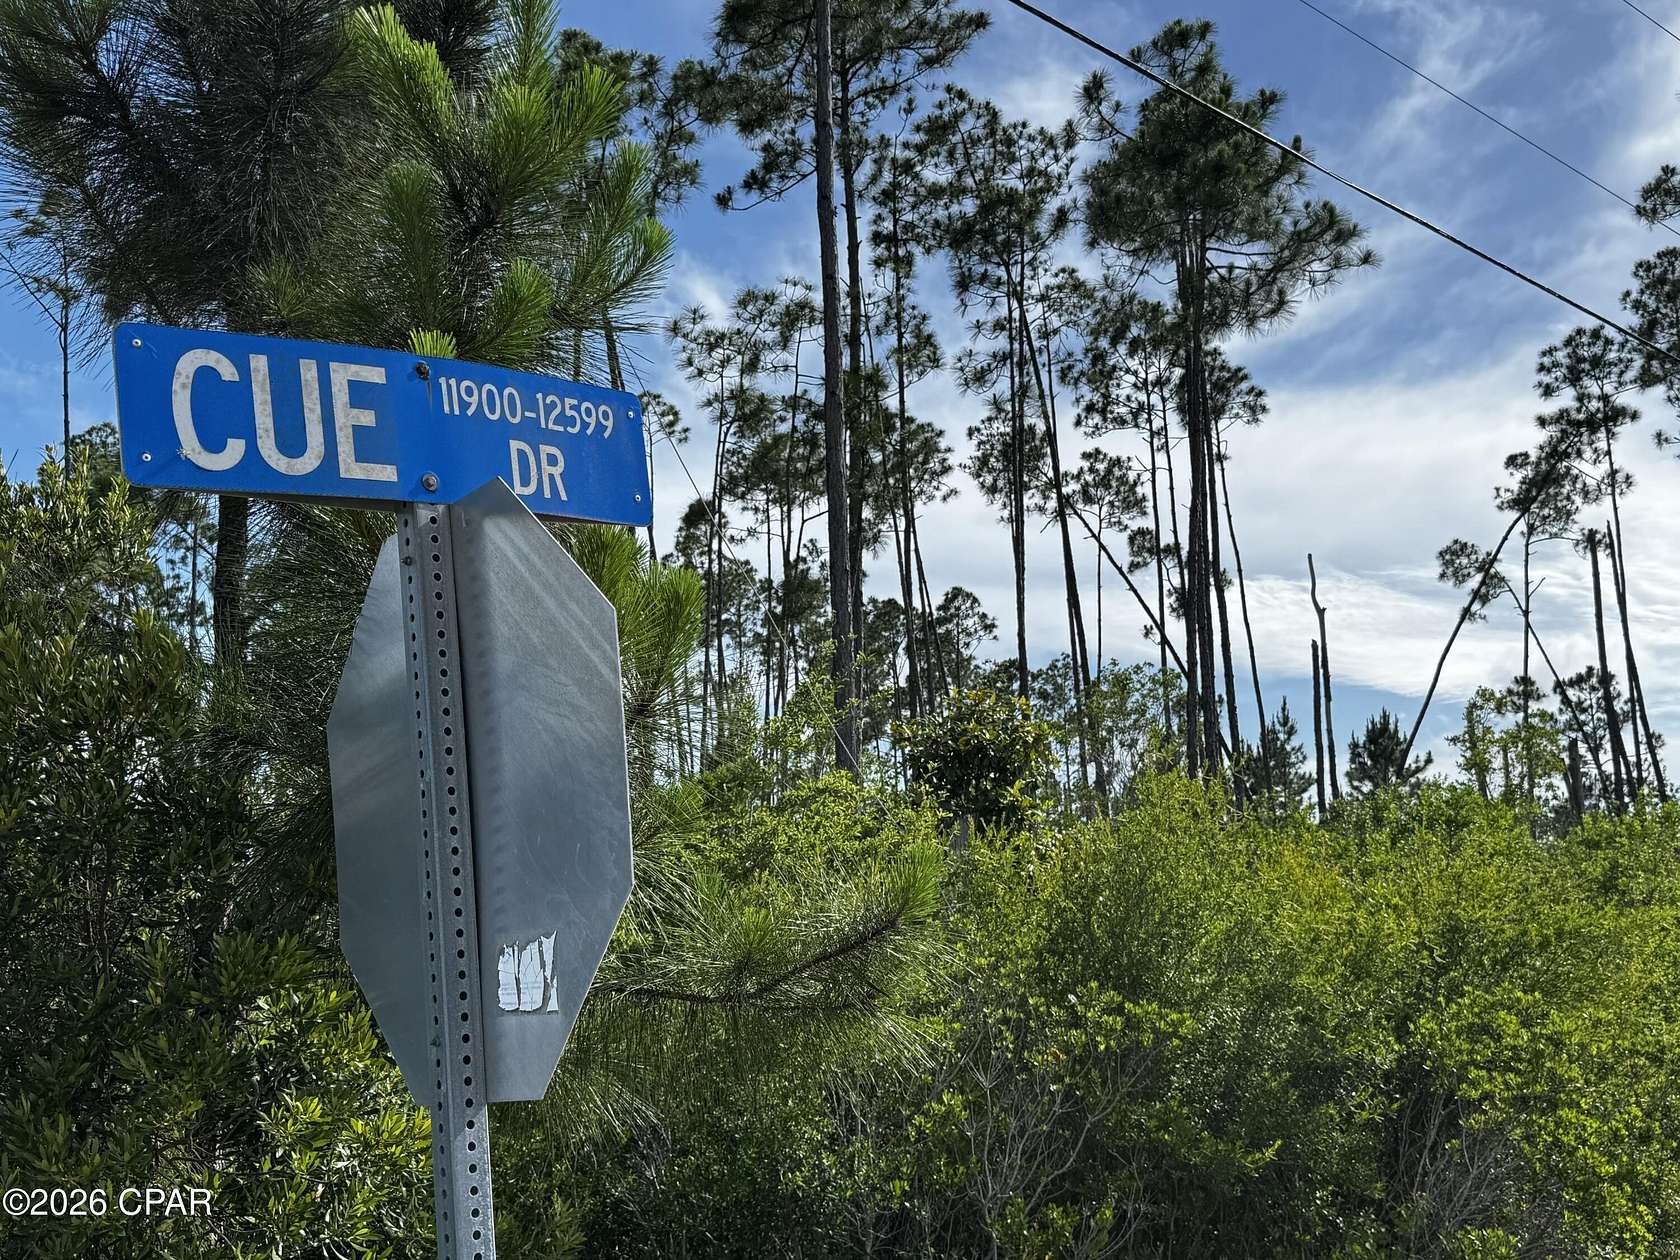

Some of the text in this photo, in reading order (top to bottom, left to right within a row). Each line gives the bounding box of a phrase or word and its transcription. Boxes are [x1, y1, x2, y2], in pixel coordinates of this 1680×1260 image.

[172, 348, 398, 482] CUE
[438, 376, 614, 439] 11900-12599
[508, 439, 568, 502] DR
